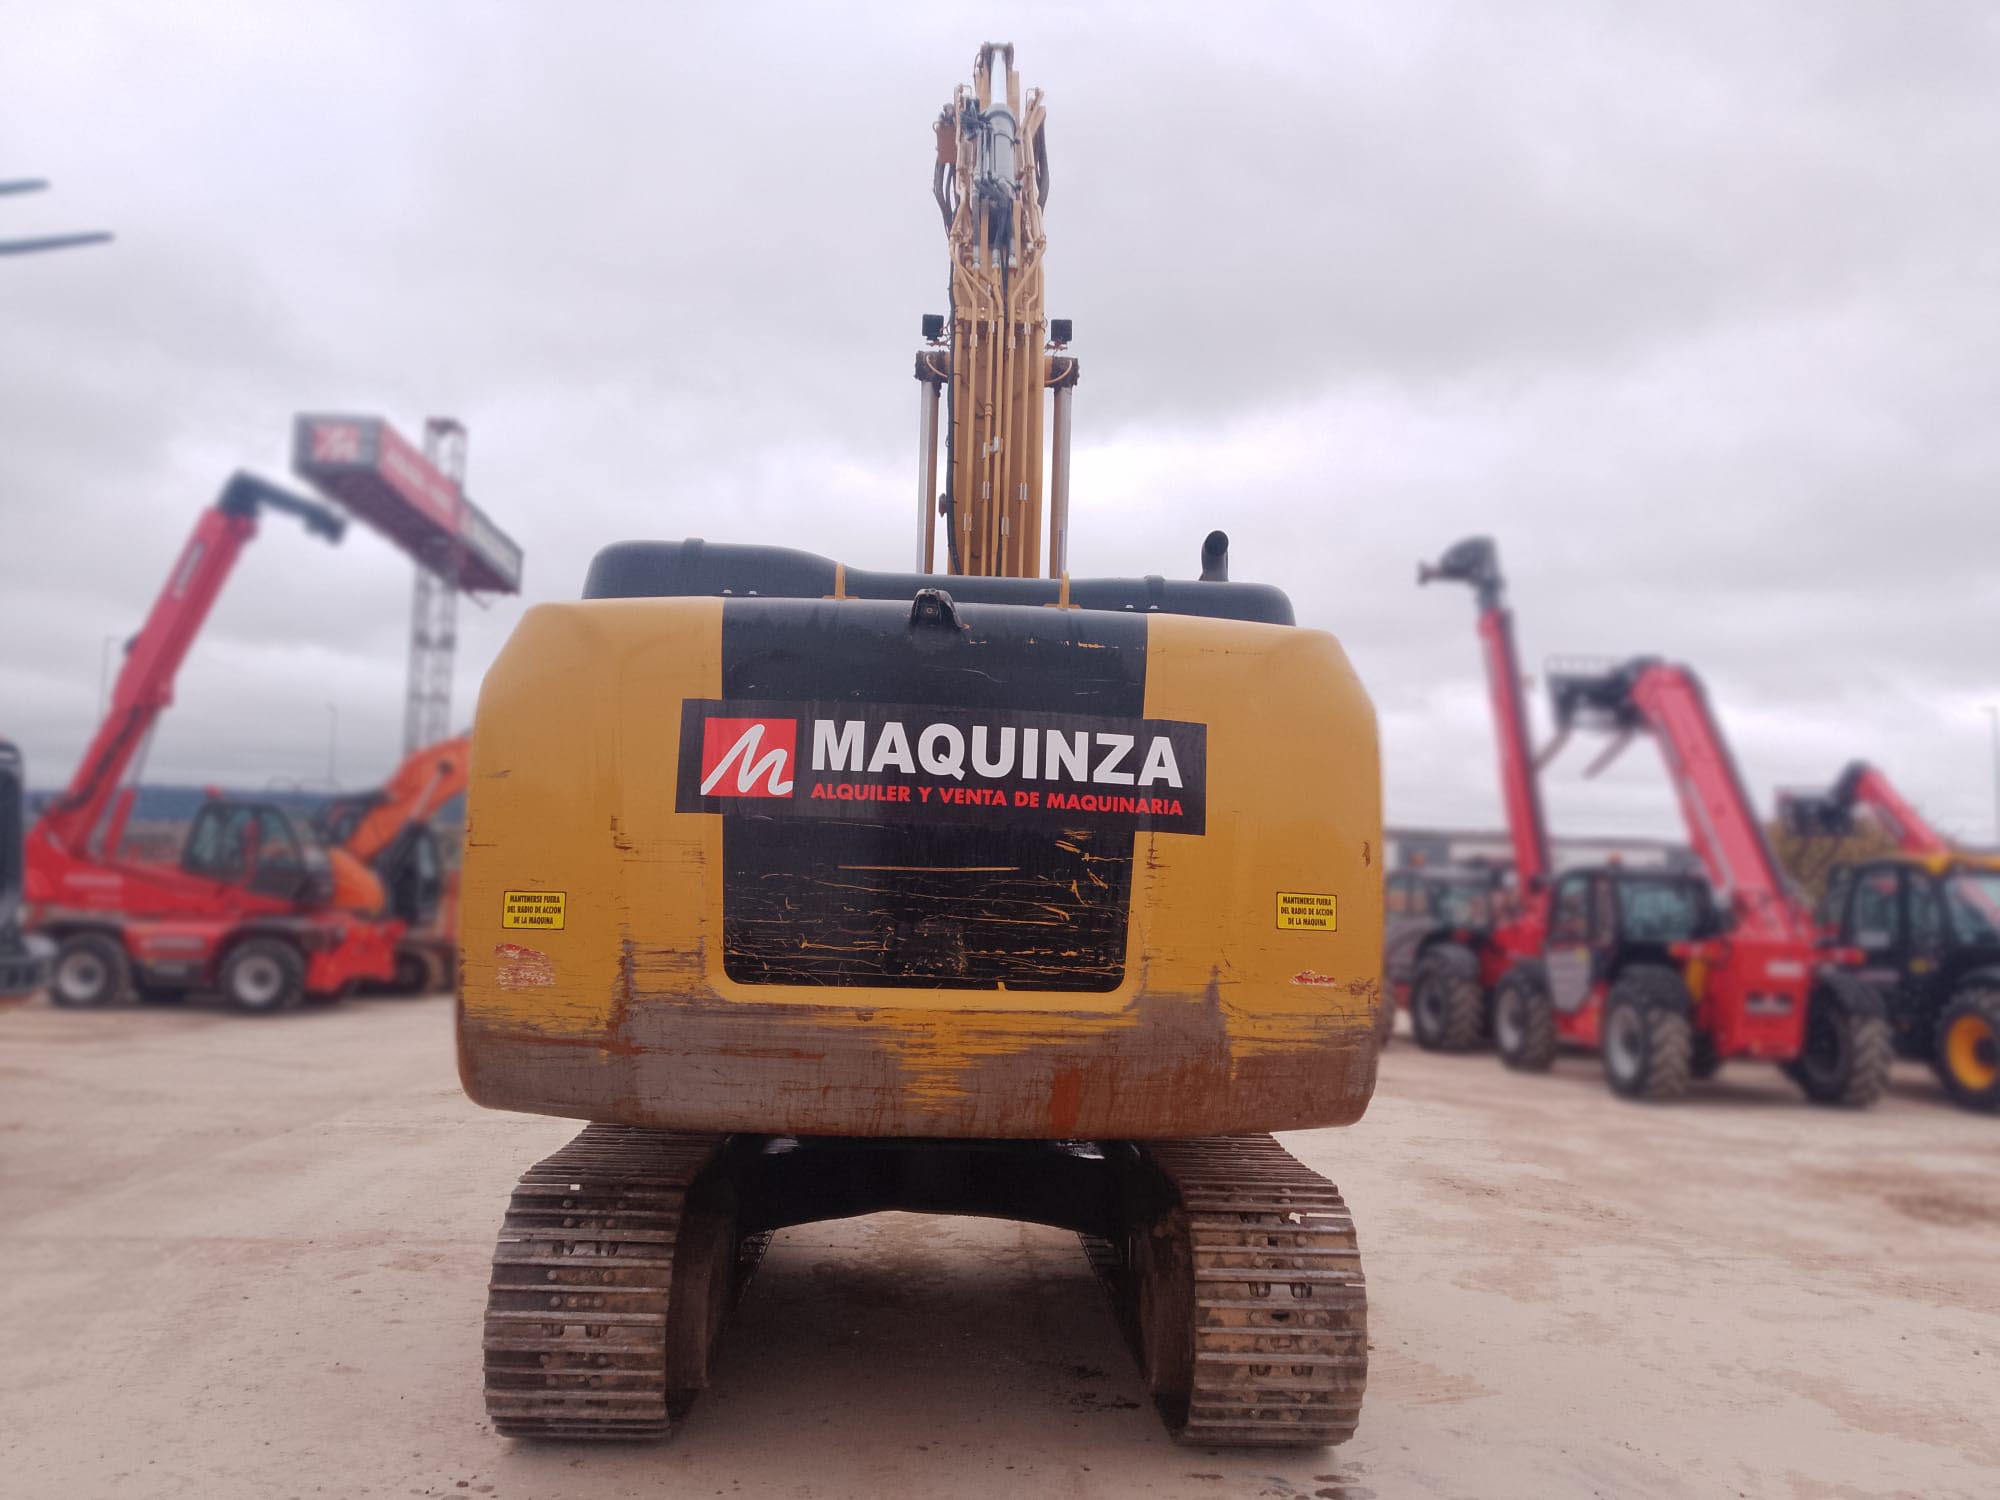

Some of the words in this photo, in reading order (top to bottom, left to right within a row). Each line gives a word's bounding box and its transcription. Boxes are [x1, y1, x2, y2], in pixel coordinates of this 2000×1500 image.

[811, 719, 1184, 789] MAQUINZA
[811, 783, 911, 803] ALQUILER
[918, 787, 933, 803] Y
[938, 787, 1007, 807] VENTA
[1014, 790, 1040, 809] DE
[1046, 792, 1184, 817] MAQUINARIA
[510, 895, 542, 903] MANTENERSE
[544, 896, 560, 904] FUERA
[1282, 896, 1315, 905] MANTENERSE
[1316, 898, 1332, 906] FUERA
[507, 905, 516, 913] DEL
[517, 905, 533, 913] RADIO
[535, 906, 542, 914] DE
[1280, 906, 1290, 914] DEL
[1291, 907, 1308, 915] RADIO
[1308, 908, 1315, 916] DE
[513, 916, 520, 924] DE
[521, 916, 528, 924] LA
[1287, 917, 1294, 925] DE
[1295, 917, 1302, 925] LA
